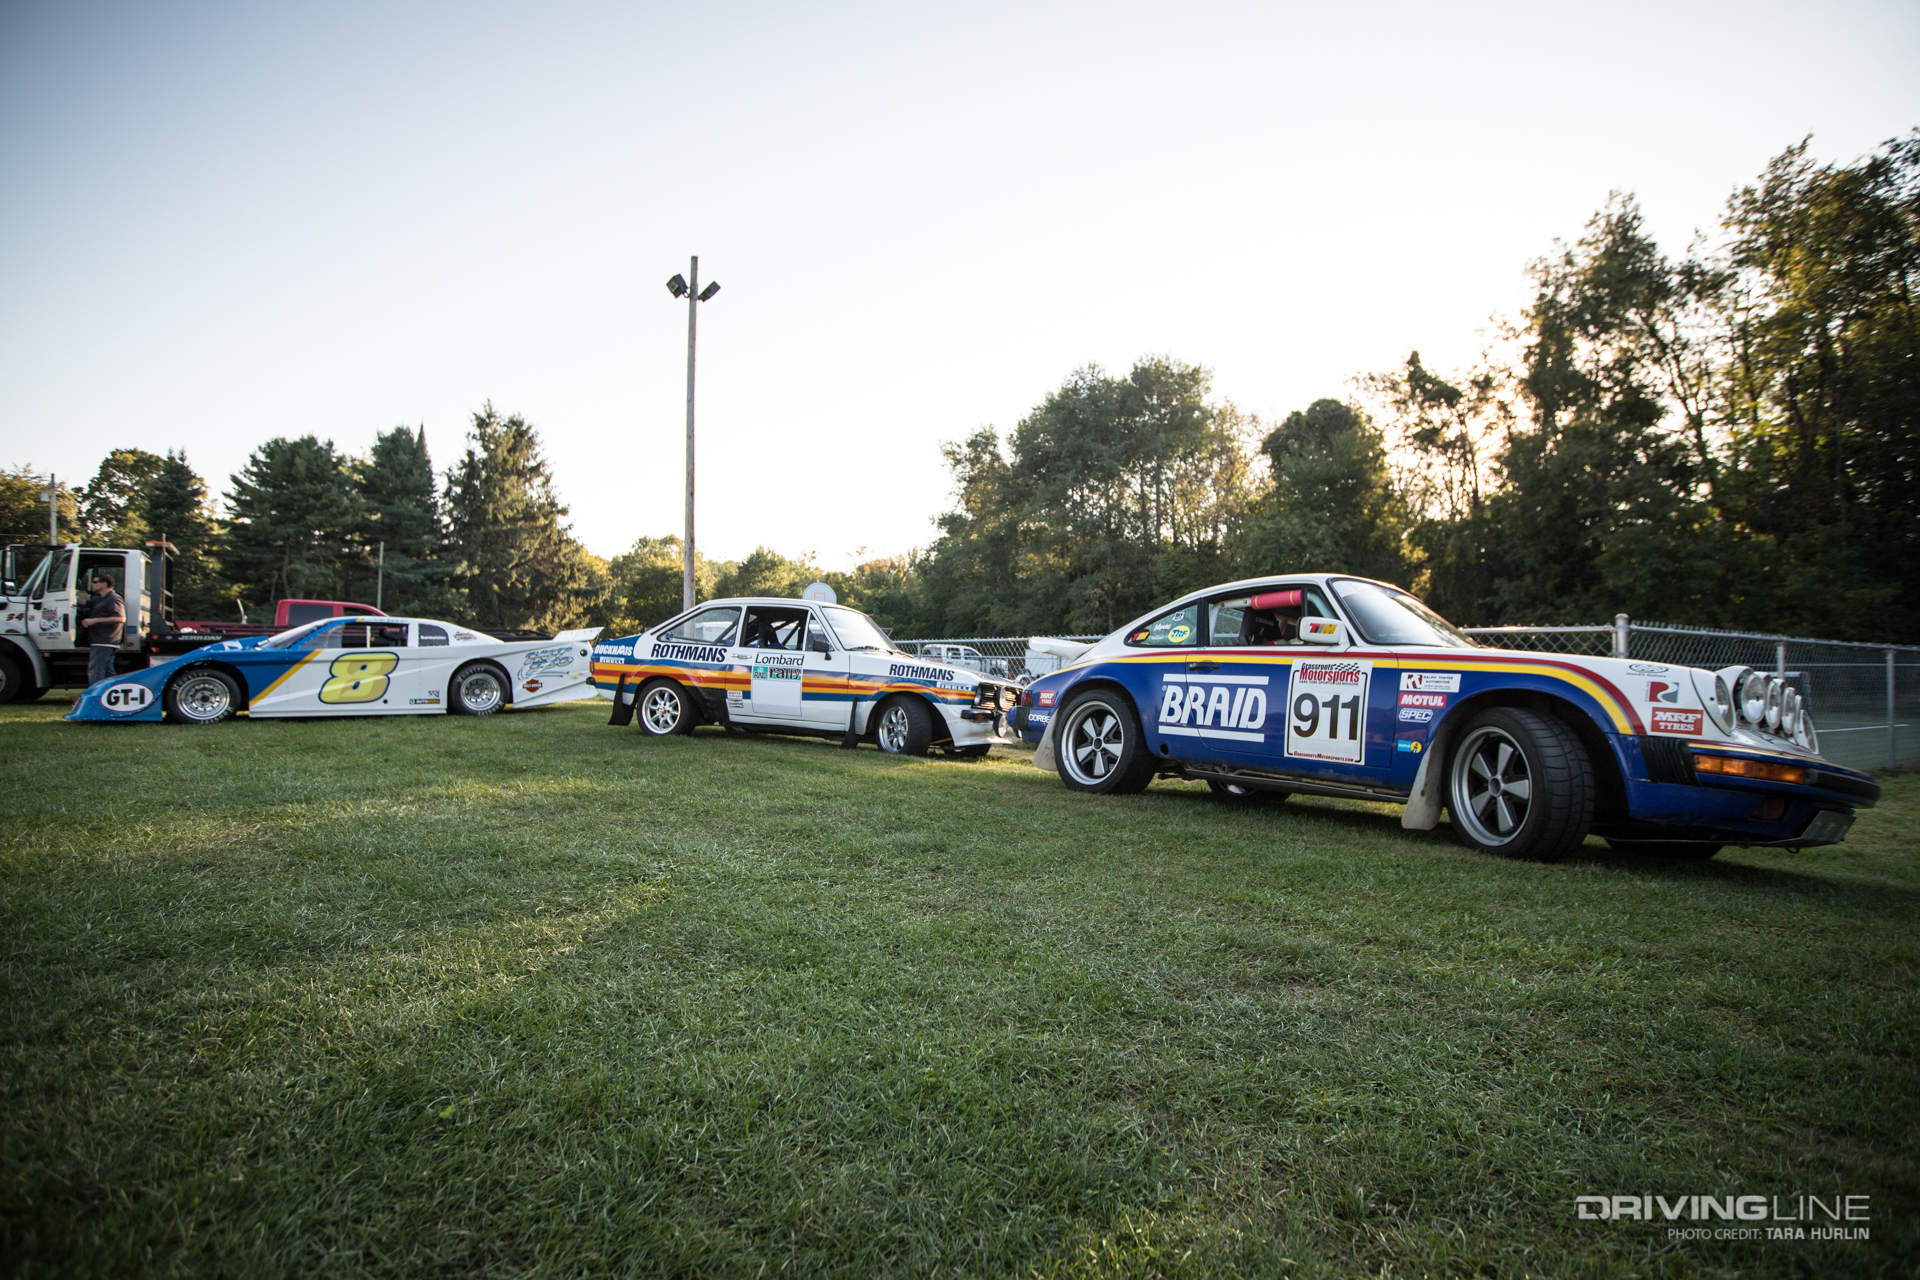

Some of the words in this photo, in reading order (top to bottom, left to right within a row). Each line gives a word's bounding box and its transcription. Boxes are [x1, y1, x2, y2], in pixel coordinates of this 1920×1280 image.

[650, 643, 728, 663] ROTHMANS
[754, 653, 805, 667] Lombard
[889, 663, 955, 681] ROTHMANS
[1301, 662, 1335, 670] Grassroots
[318, 651, 400, 704] 8
[769, 667, 802, 680] rally
[1299, 668, 1360, 685] Motorsports
[1158, 684, 1267, 730] BRAID
[1400, 694, 1445, 707] MOTUL
[1293, 692, 1361, 741] 911
[1400, 710, 1431, 720] SPEC
[1653, 711, 1701, 724] MRF
[1659, 722, 1695, 732] TYRES
